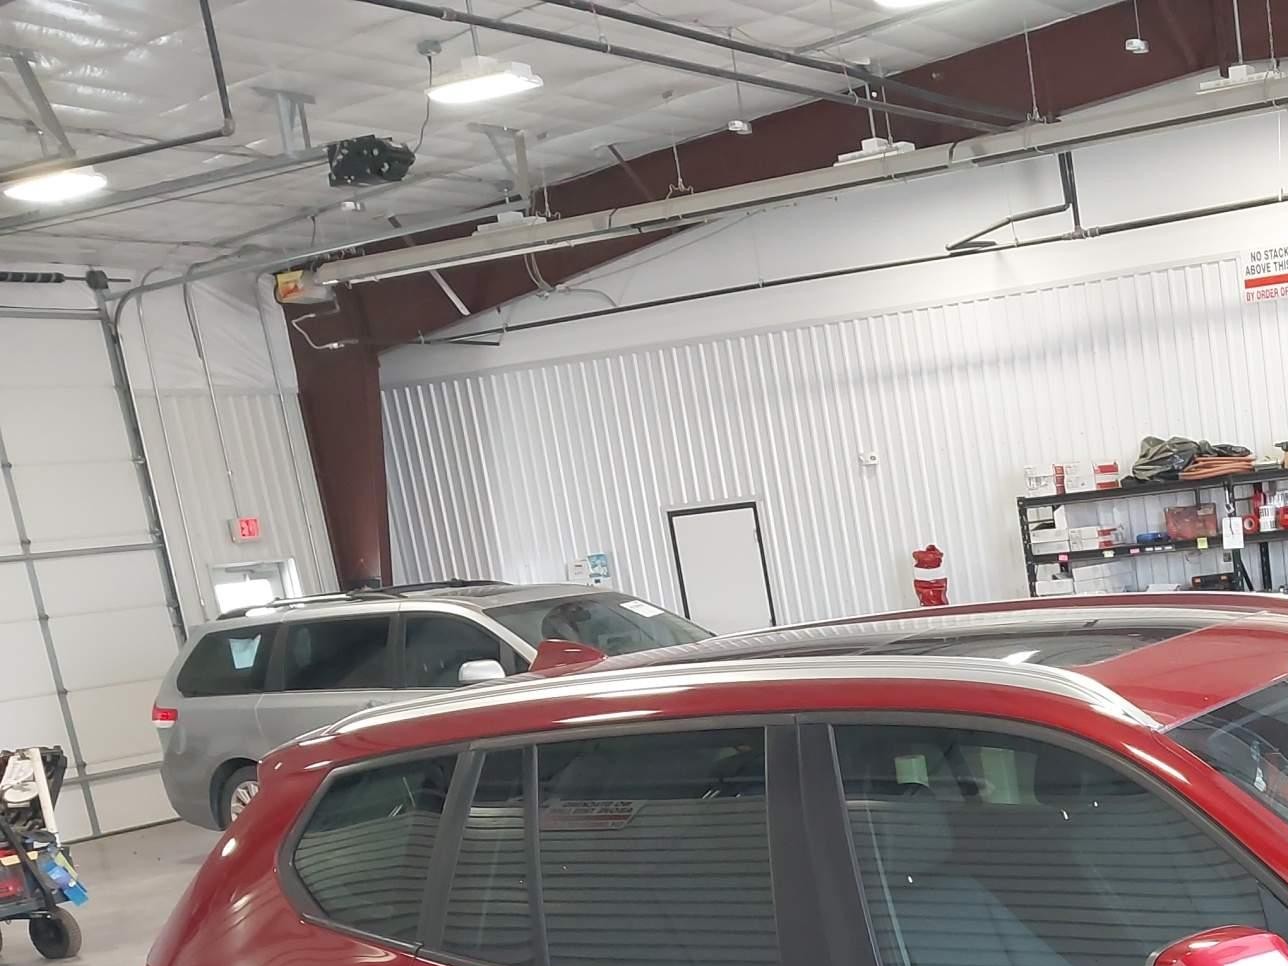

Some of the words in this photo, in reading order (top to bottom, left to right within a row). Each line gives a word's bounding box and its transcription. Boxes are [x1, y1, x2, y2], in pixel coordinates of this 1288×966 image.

[1250, 250, 1262, 262] NO
[1245, 262, 1271, 275] ABOVE
[1246, 290, 1255, 302] BY
[1256, 288, 1279, 300] ORDER
[1280, 286, 1288, 296] OF
